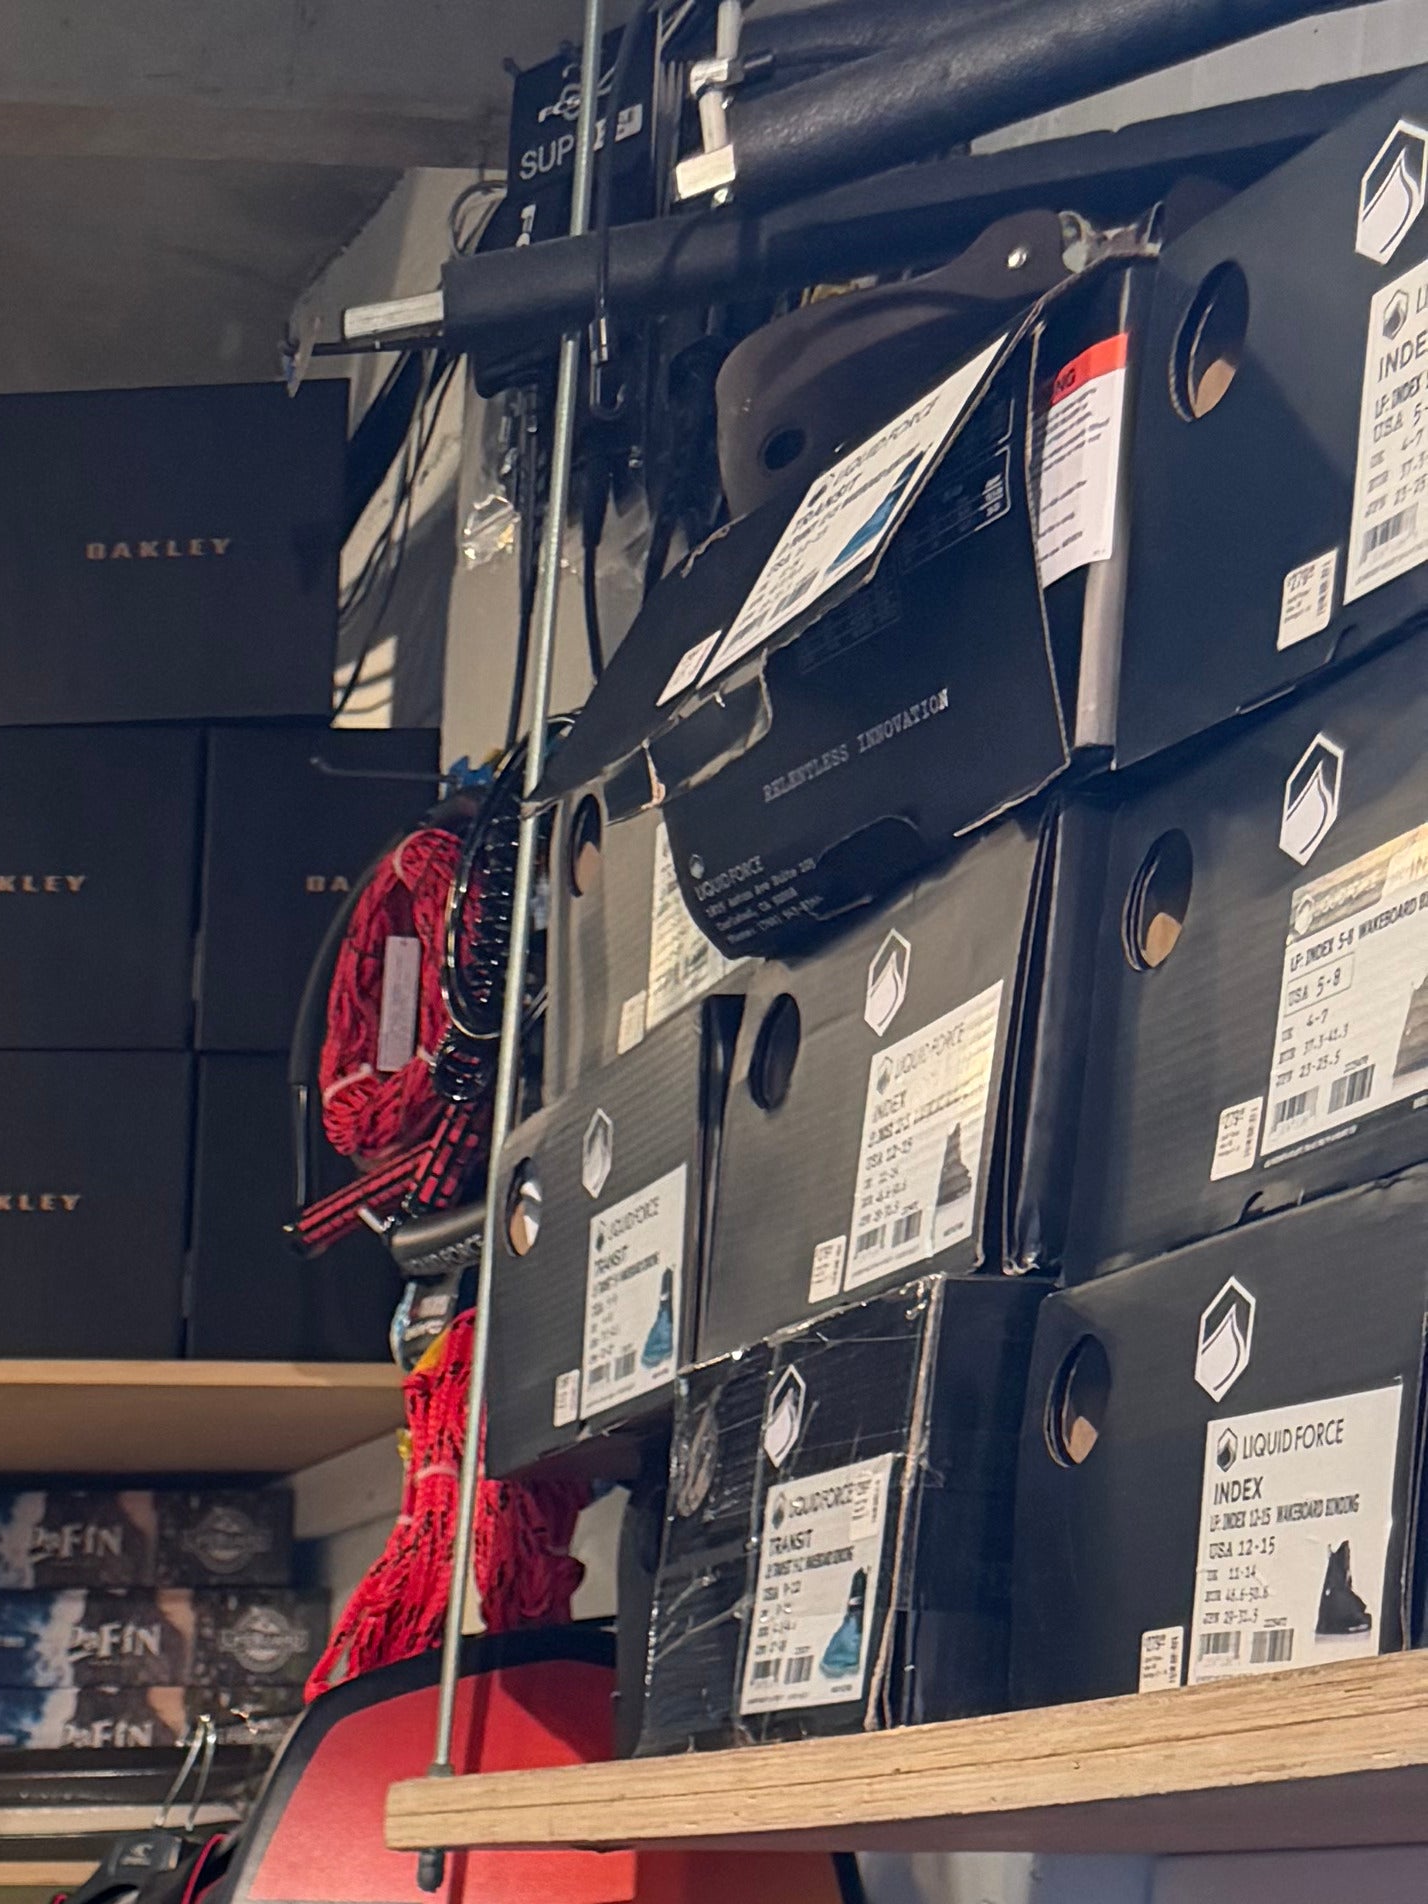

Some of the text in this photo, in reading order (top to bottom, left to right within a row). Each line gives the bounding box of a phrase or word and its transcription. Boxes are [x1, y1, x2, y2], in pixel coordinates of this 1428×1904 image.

[84, 537, 233, 561] OAKLEY
[761, 686, 950, 804] RELENTLESS INNOVATION
[1242, 1417, 1345, 1460] LIQUID FORCE
[1213, 1476, 1264, 1506] INDEX
